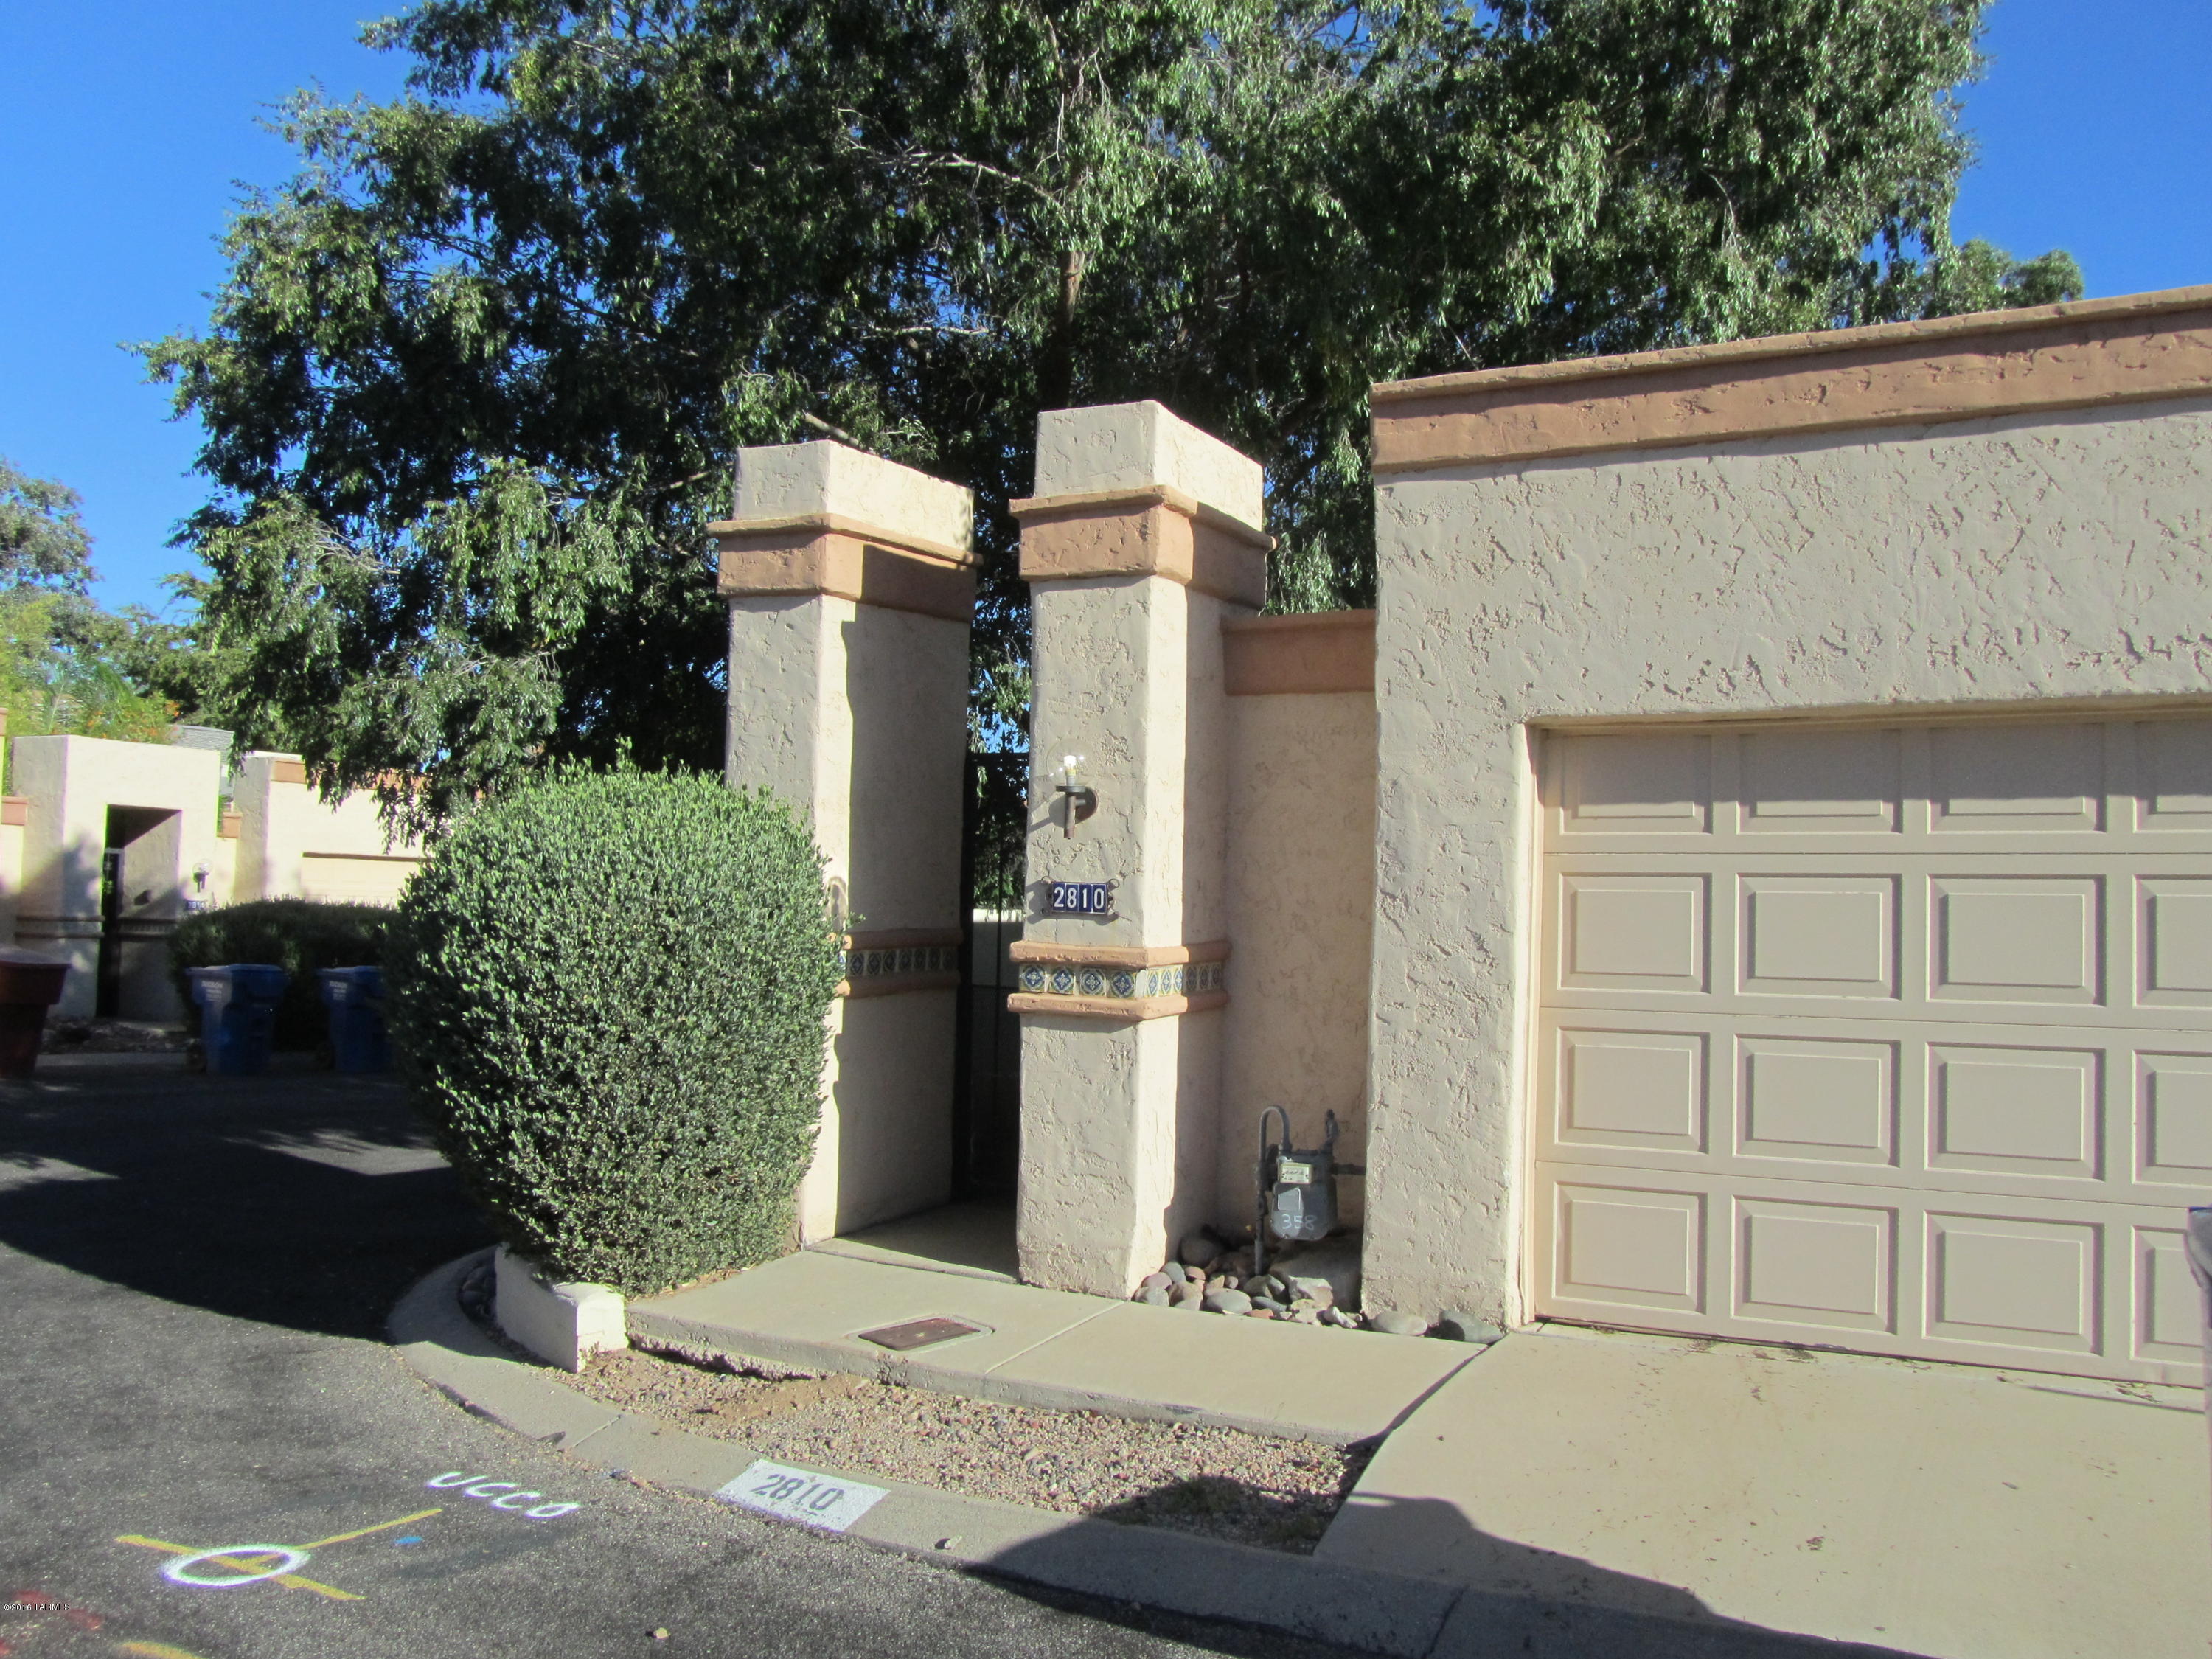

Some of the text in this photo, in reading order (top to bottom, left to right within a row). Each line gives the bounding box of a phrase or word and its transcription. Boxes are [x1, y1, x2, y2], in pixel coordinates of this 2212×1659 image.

[1054, 887, 1105, 909] 2810
[1282, 1214, 1317, 1230] 358
[750, 1474, 845, 1510] 2810
